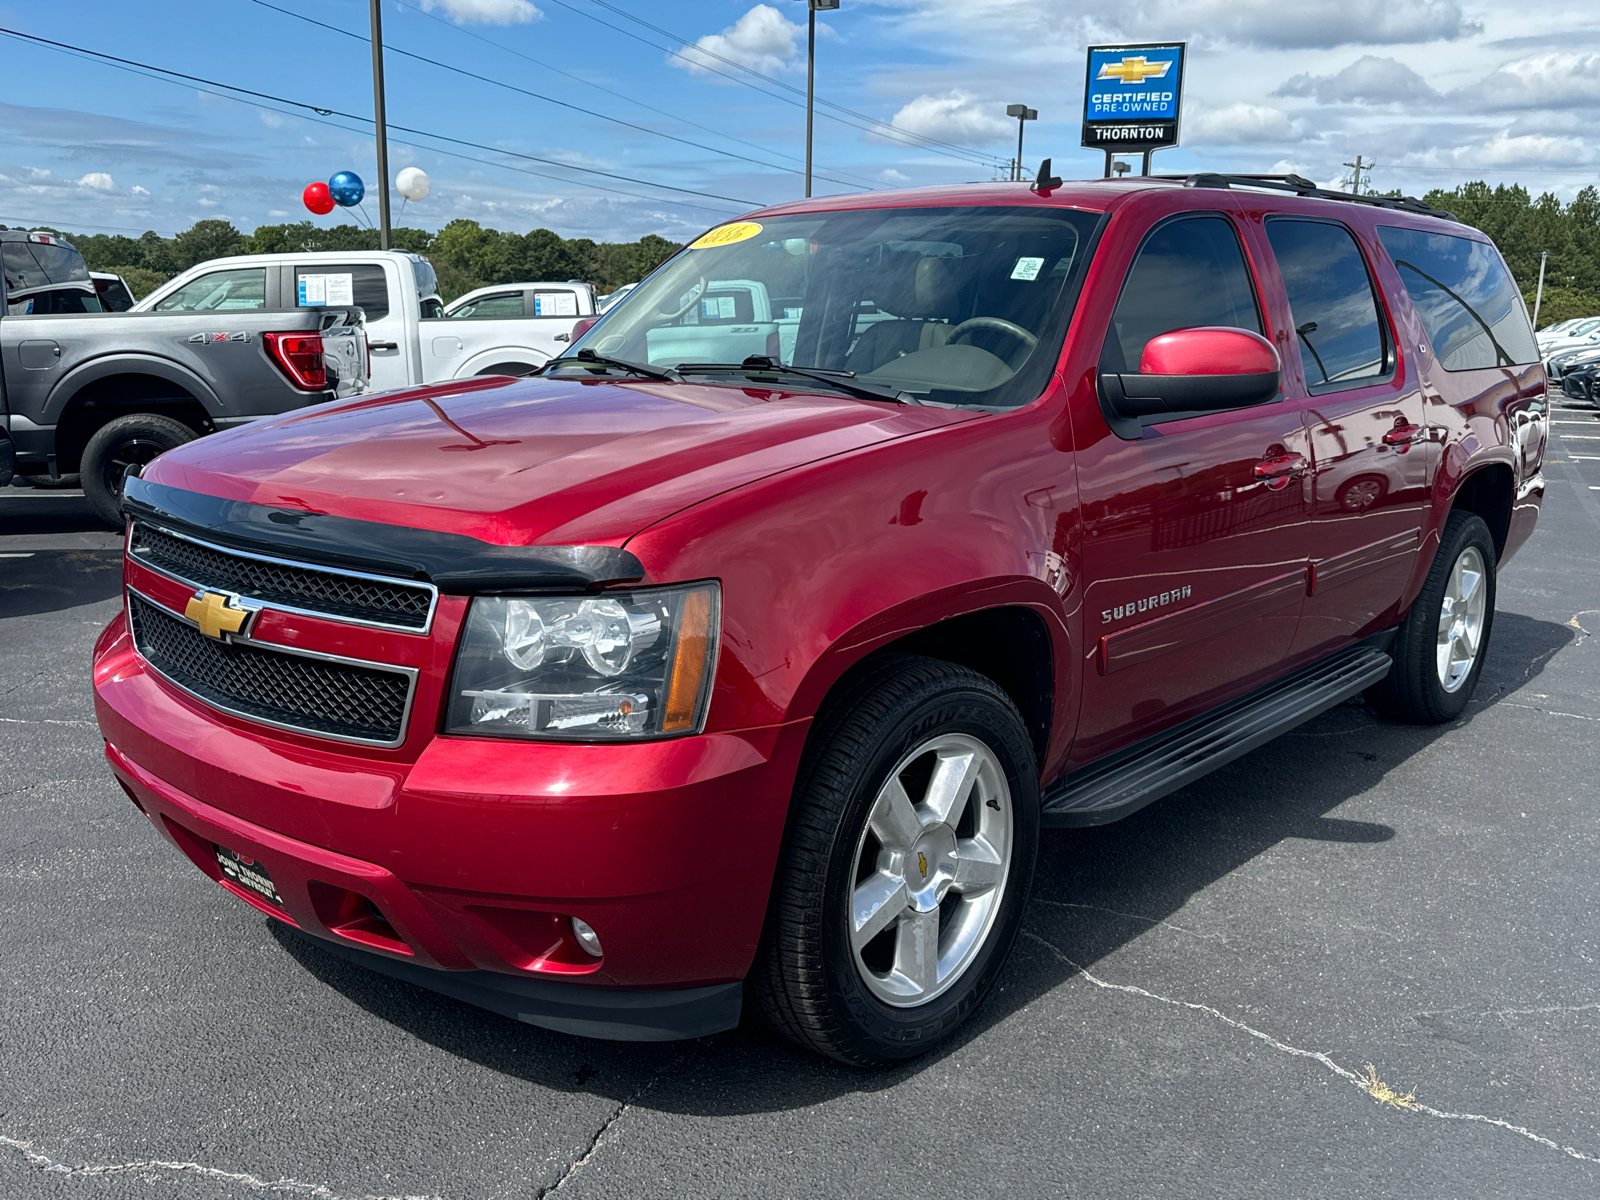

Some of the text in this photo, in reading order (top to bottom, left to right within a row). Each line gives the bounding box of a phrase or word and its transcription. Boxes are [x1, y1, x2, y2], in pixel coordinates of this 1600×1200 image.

[1091, 92, 1173, 103] CERTIFIED
[1094, 102, 1168, 112] PRE-OWNED
[1095, 127, 1164, 140] THORNTON
[1101, 584, 1192, 624] SUBURBAN
[904, 704, 1029, 774] BRIDGESTONE
[216, 852, 240, 873] JOHN
[240, 865, 276, 893] THORNT
